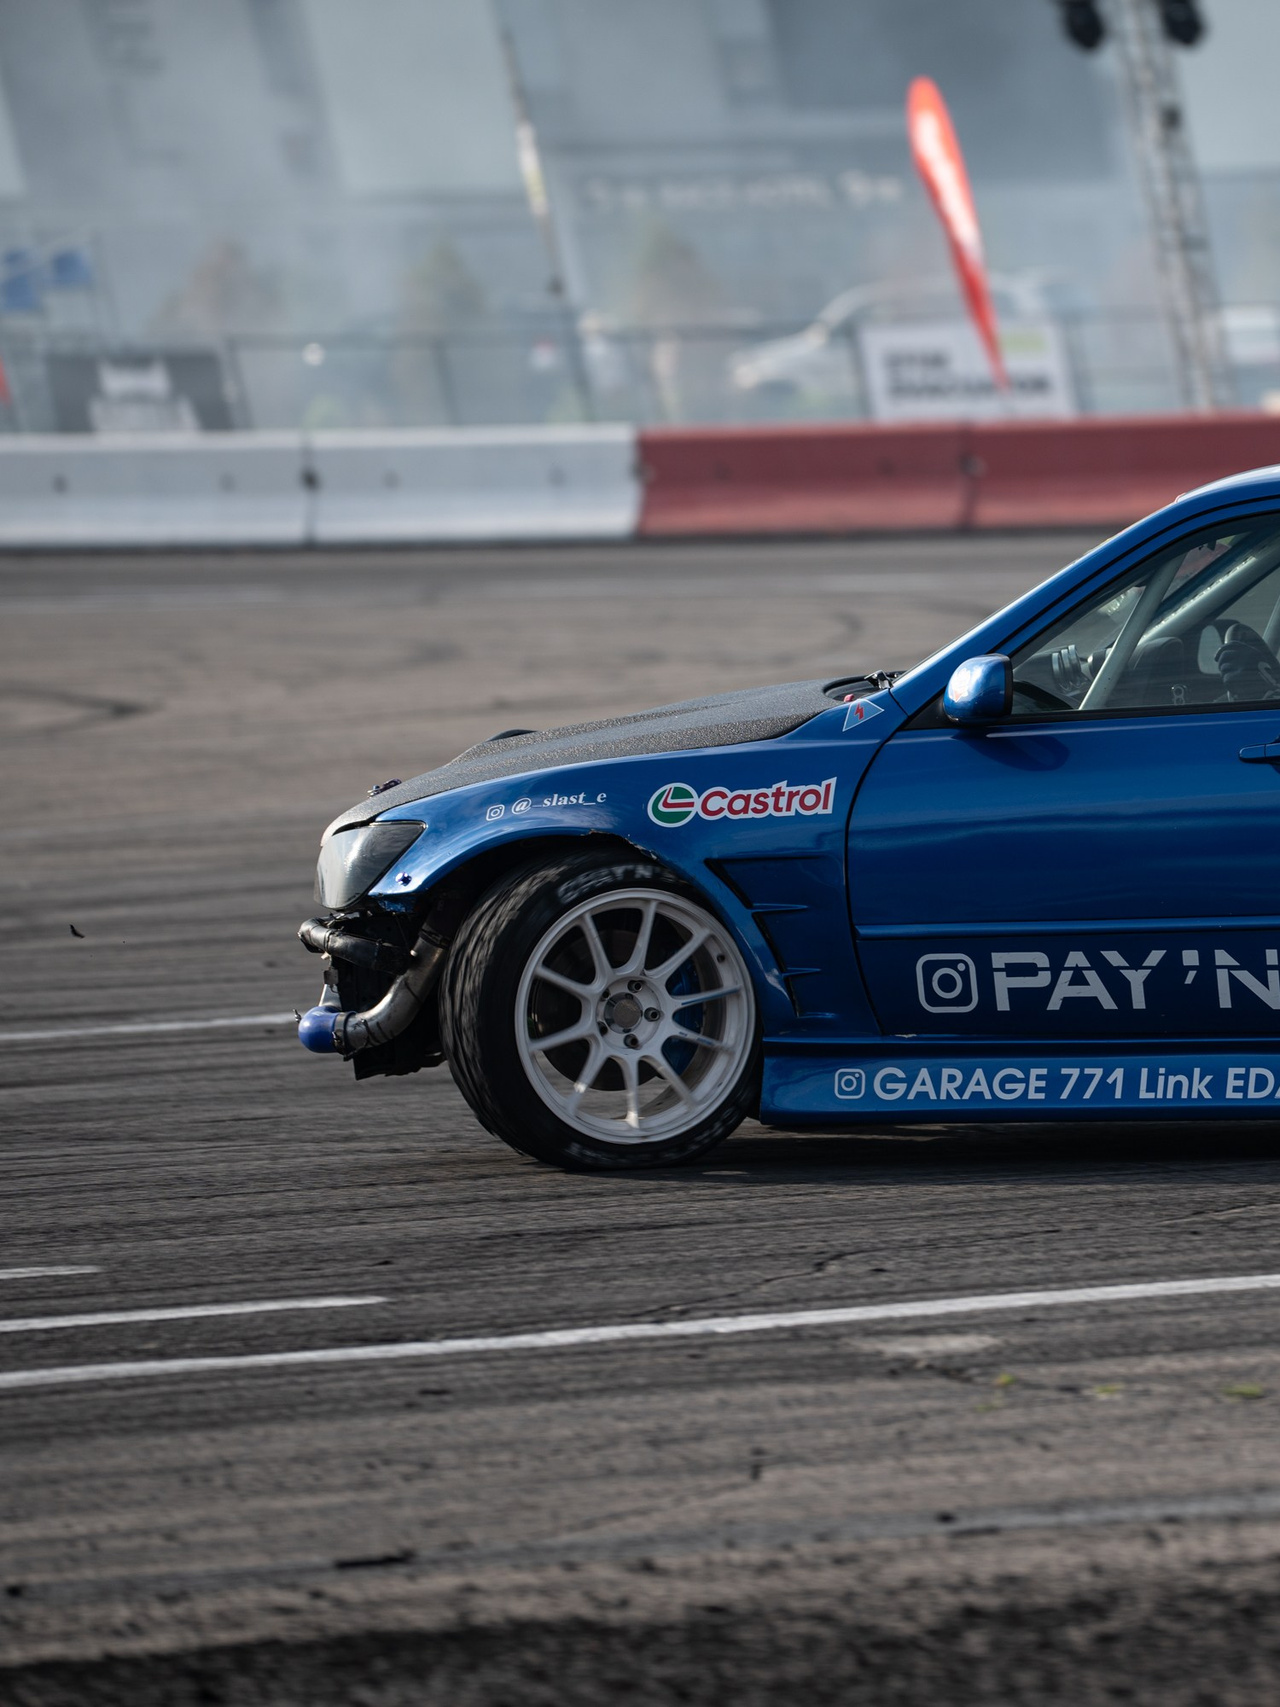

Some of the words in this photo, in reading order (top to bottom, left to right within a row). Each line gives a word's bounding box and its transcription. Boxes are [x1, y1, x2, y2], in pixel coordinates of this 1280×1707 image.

[700, 780, 834, 818] Castrol
[873, 1067, 1048, 1100] GARAGE
[1060, 1068, 1124, 1099] 771
[1139, 1067, 1213, 1099] Link
